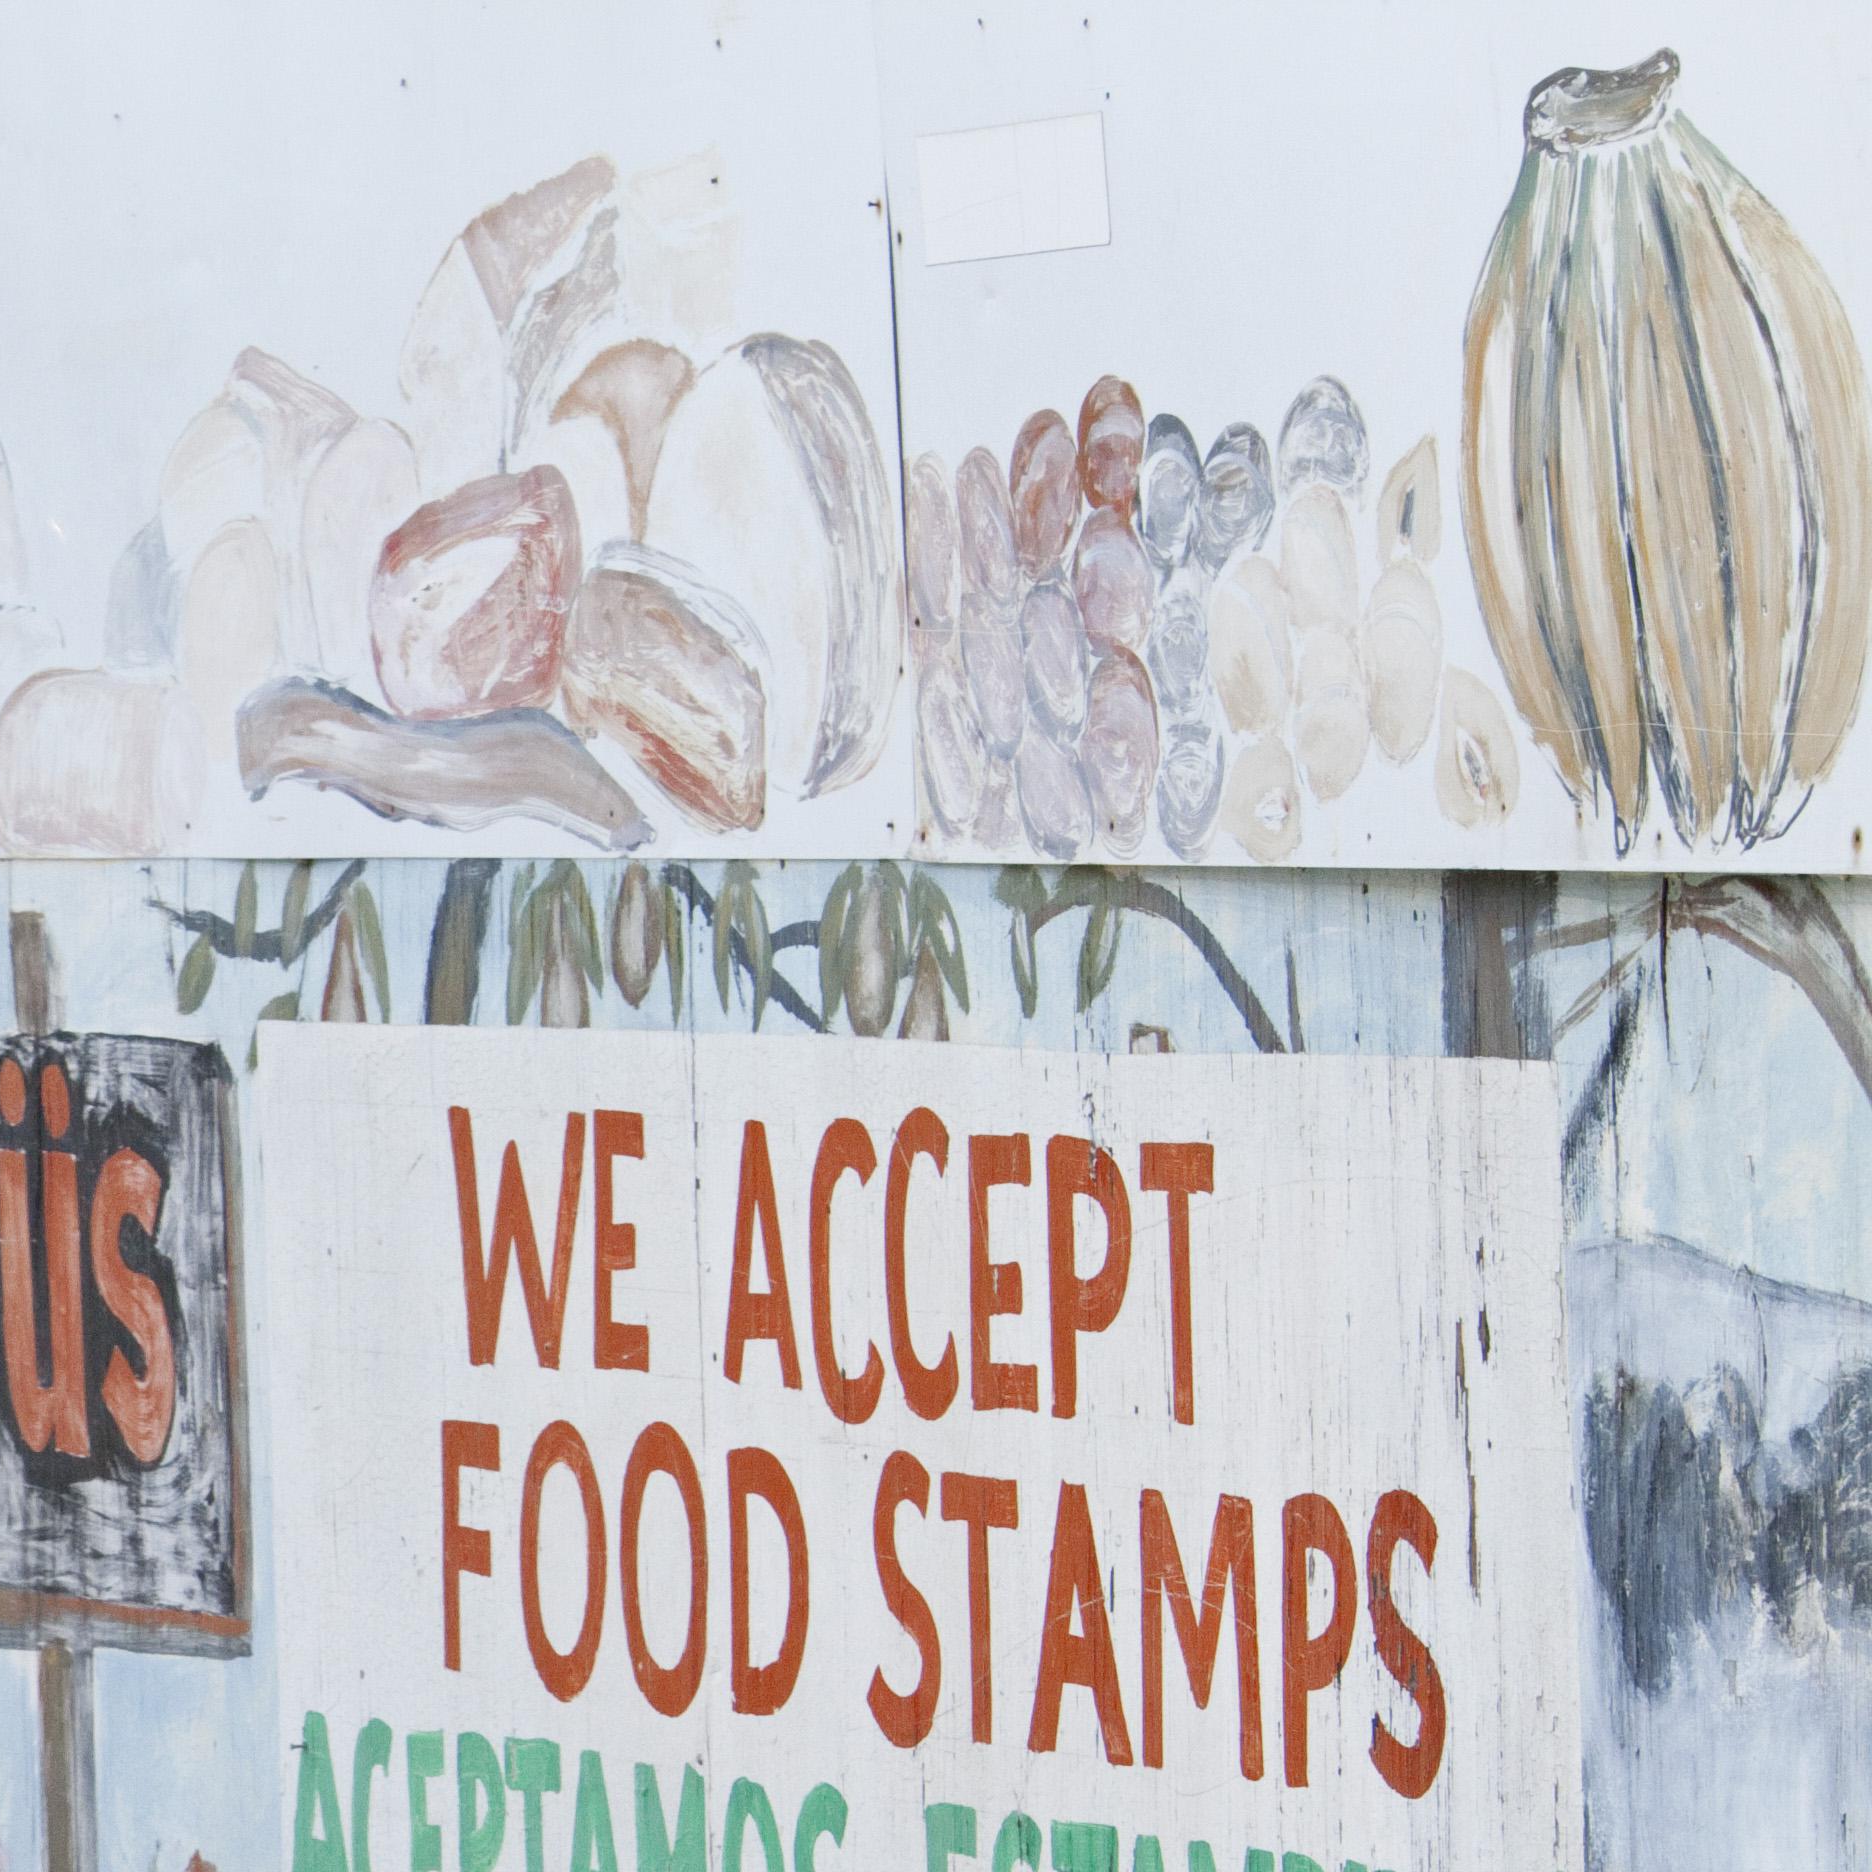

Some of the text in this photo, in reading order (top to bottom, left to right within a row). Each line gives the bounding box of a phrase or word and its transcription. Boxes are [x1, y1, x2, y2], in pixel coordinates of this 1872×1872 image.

[448, 1106, 1214, 1425] WE ACCEPT
[442, 1420, 1446, 1799] FOOD STAMPS
